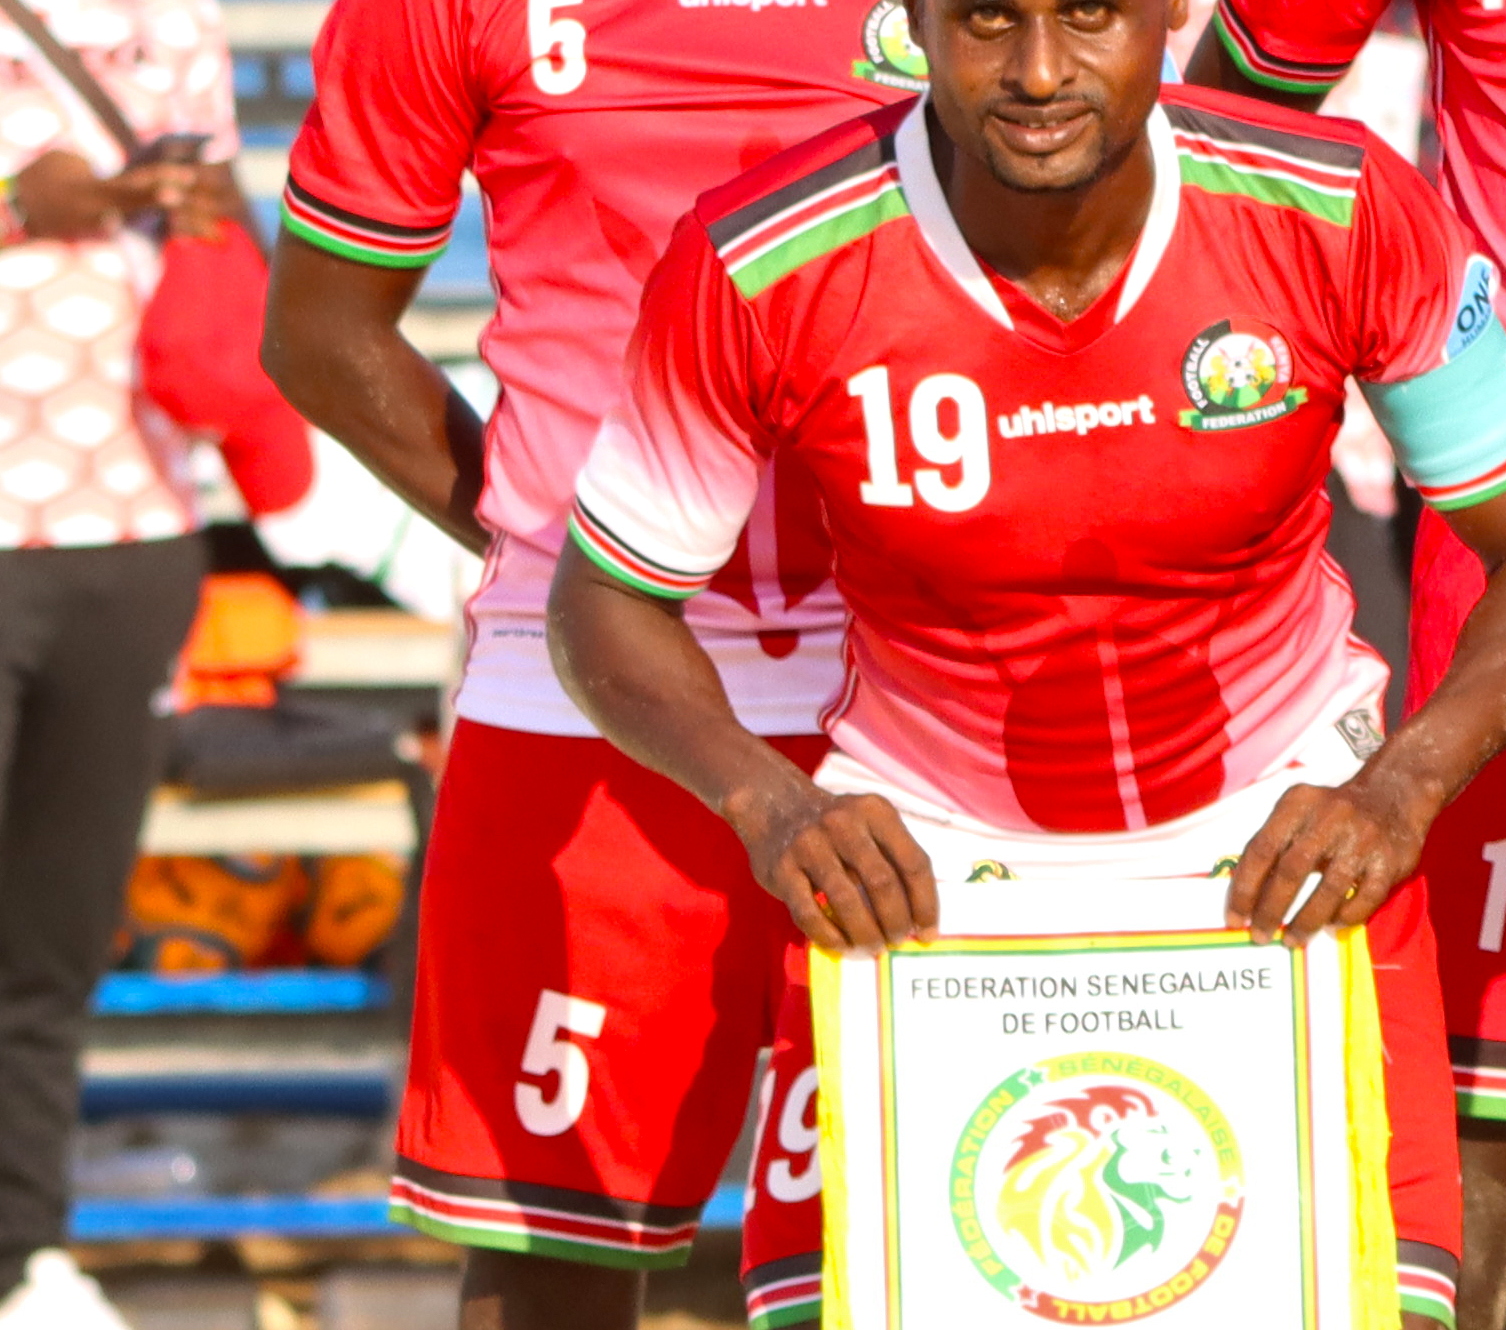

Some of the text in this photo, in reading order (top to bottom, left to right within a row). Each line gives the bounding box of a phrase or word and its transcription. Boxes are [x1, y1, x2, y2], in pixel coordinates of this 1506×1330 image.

[1185, 338, 1210, 409] FOOTBALL
[847, 366, 991, 513] 19
[998, 395, 1155, 439] uhlsport
[1201, 401, 1287, 430] FEDERATION
[911, 968, 1273, 1000] FEDERATION SENEGALAISE
[1002, 1009, 1184, 1035] DE FOOTBALL
[513, 988, 607, 1137] 5
[1057, 1053, 1235, 1166] SÉNÉGALAISE
[1204, 1213, 1236, 1257] DE
[1051, 1257, 1210, 1322] FOOTBALL
